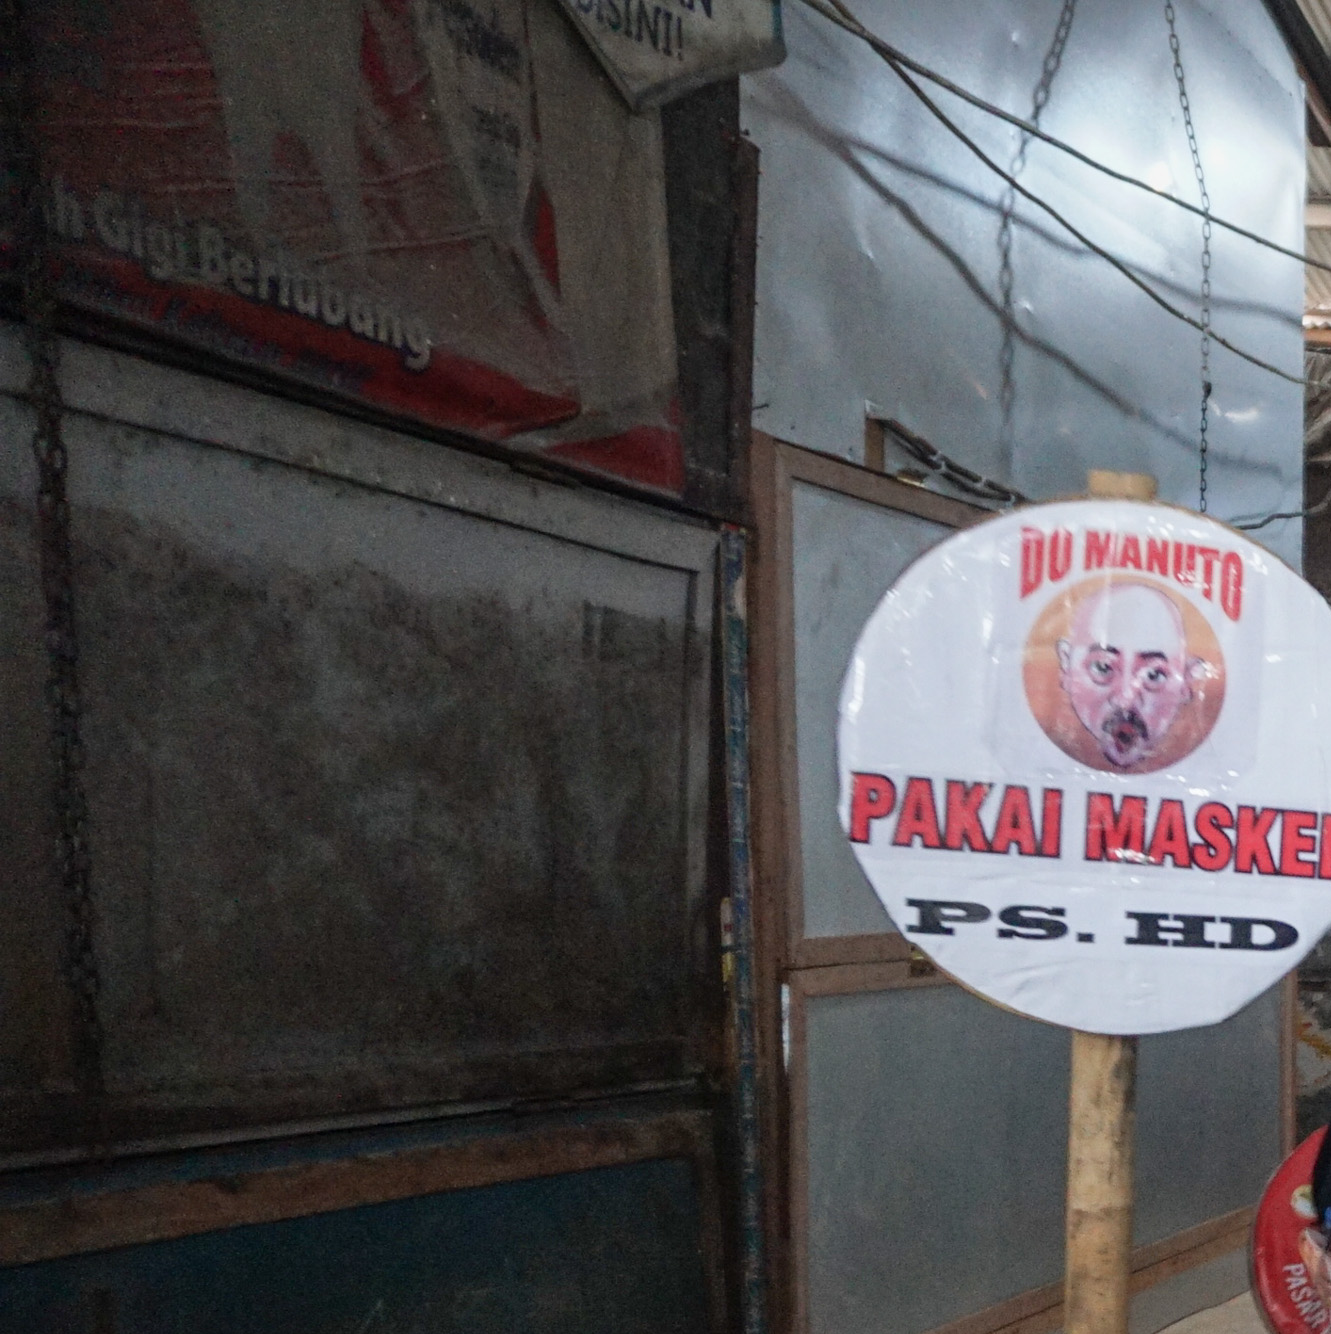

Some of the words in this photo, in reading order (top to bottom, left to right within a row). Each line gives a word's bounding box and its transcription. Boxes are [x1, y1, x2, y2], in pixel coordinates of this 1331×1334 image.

[1084, 527, 1244, 623] MANUTO
[850, 770, 1064, 860] PAKAI
[905, 897, 1096, 944] PS.
[1125, 909, 1300, 953] HD
[1282, 1263, 1329, 1329] PASAR
